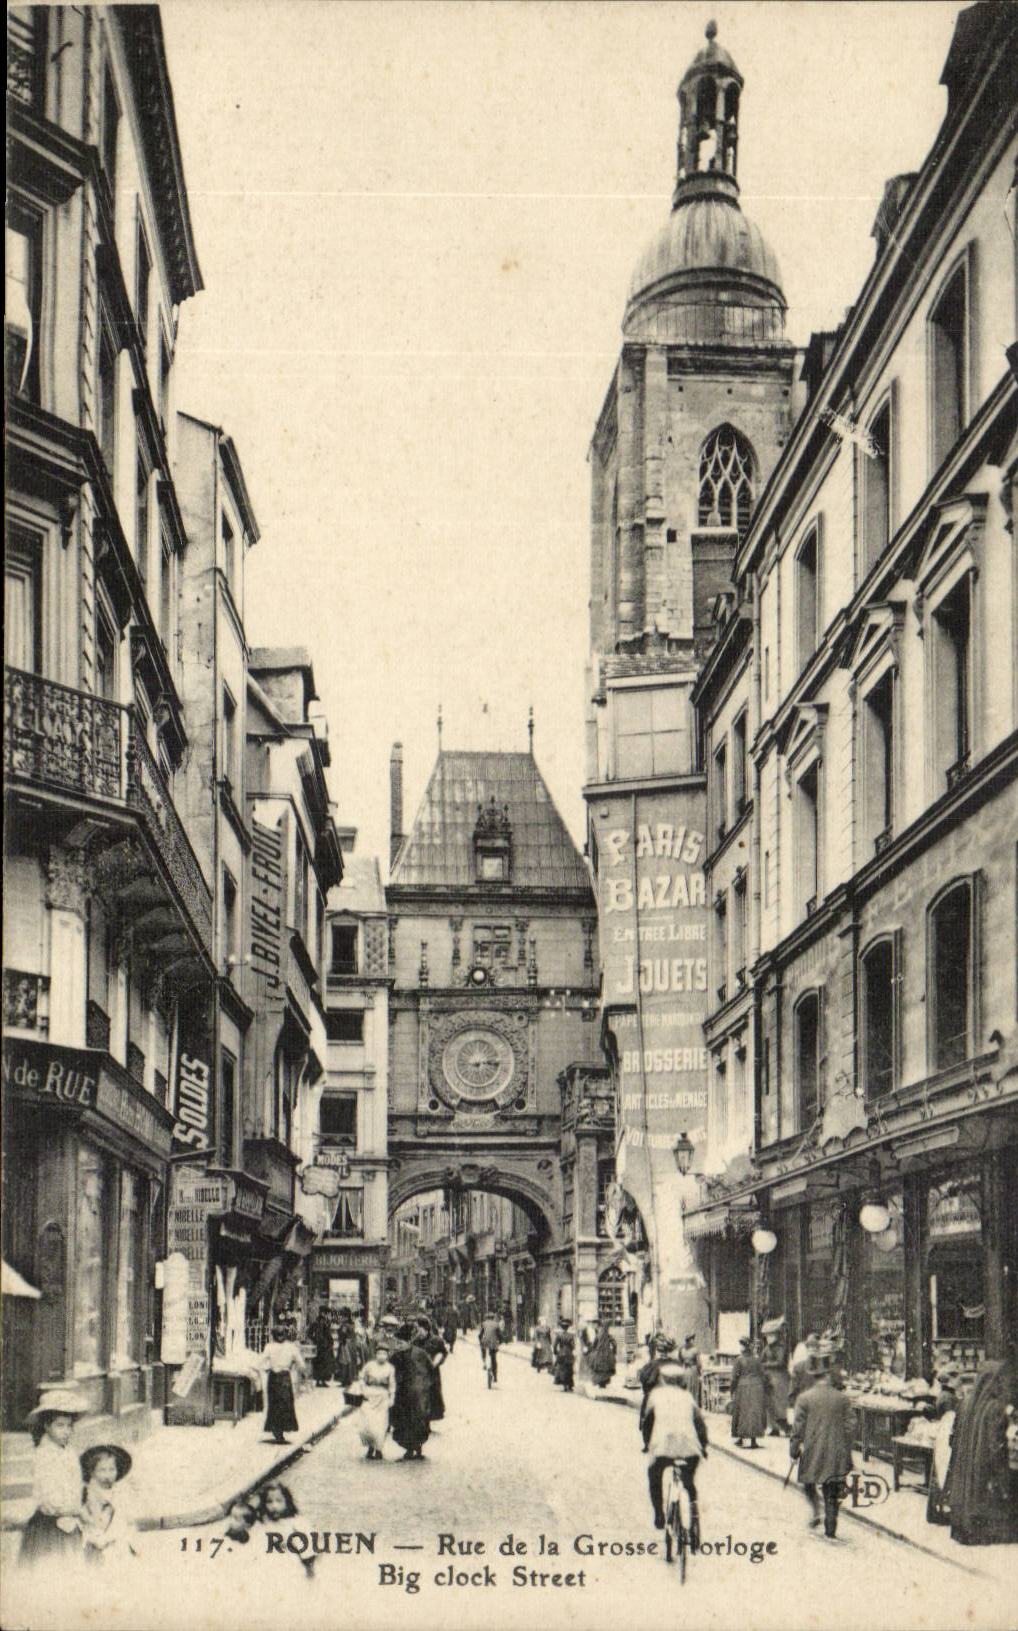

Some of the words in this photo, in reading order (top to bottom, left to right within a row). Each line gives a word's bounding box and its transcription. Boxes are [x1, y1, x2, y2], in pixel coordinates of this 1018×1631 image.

[604, 823, 704, 865] PARIS
[605, 872, 706, 913] BAZAR
[668, 923, 706, 942] LIBRE
[614, 955, 708, 993] JOUETS
[622, 1047, 708, 1072] BROSSERIE
[14, 1057, 39, 1087] de
[39, 1060, 96, 1105] RUE
[173, 1053, 210, 1149] SOLDES
[317, 1154, 348, 1166] MODES
